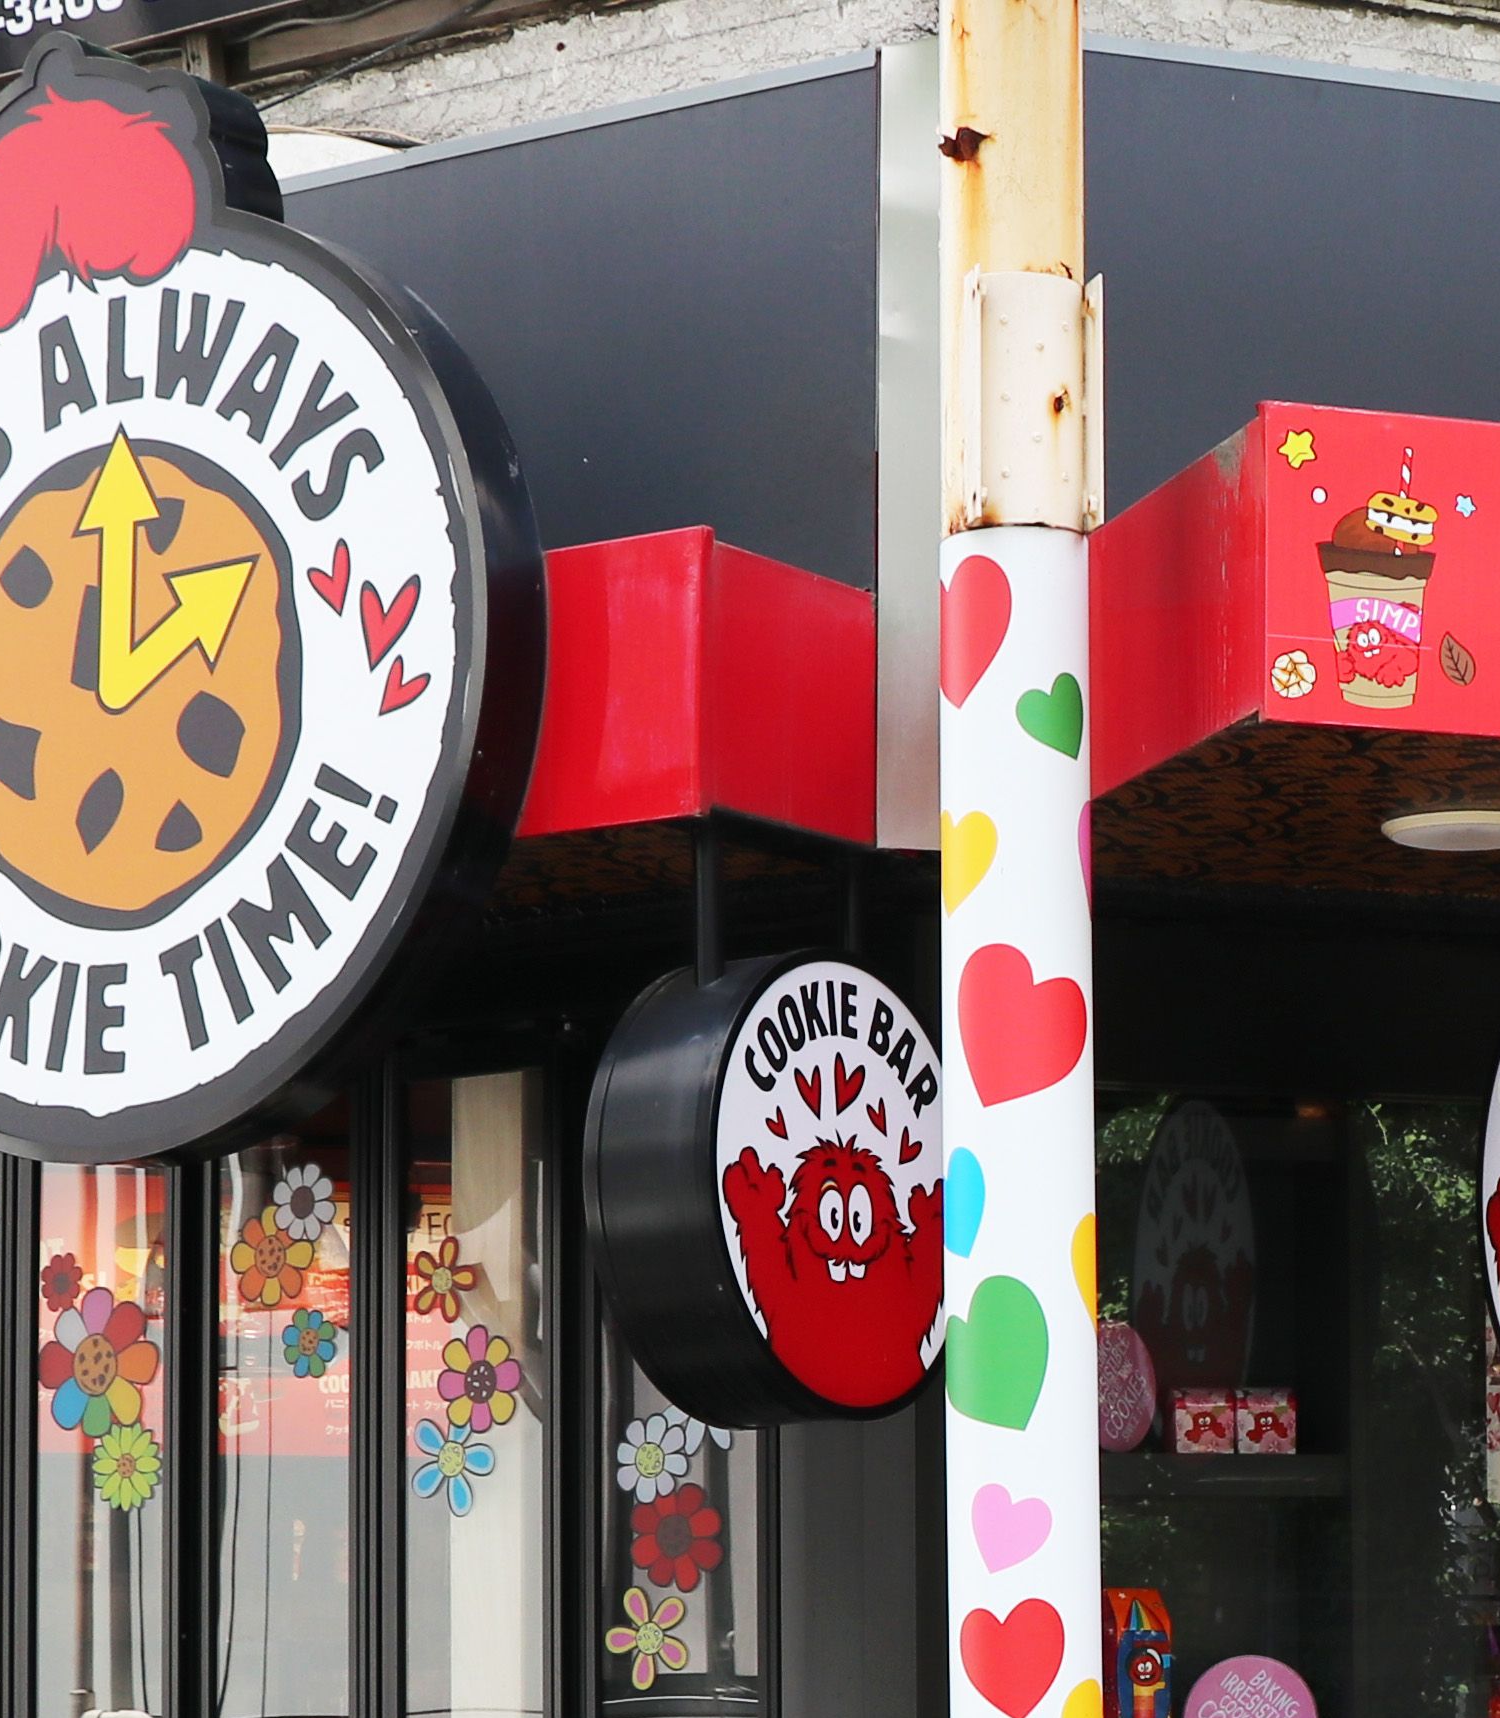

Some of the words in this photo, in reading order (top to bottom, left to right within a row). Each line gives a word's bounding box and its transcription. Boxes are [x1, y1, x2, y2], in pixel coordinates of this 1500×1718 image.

[36, 287, 384, 524] ALWAYS
[158, 760, 399, 1051] TIME!
[745, 979, 858, 1093] COOKIE
[867, 997, 938, 1119] BAR
[1248, 1669, 1301, 1718] BAKING
